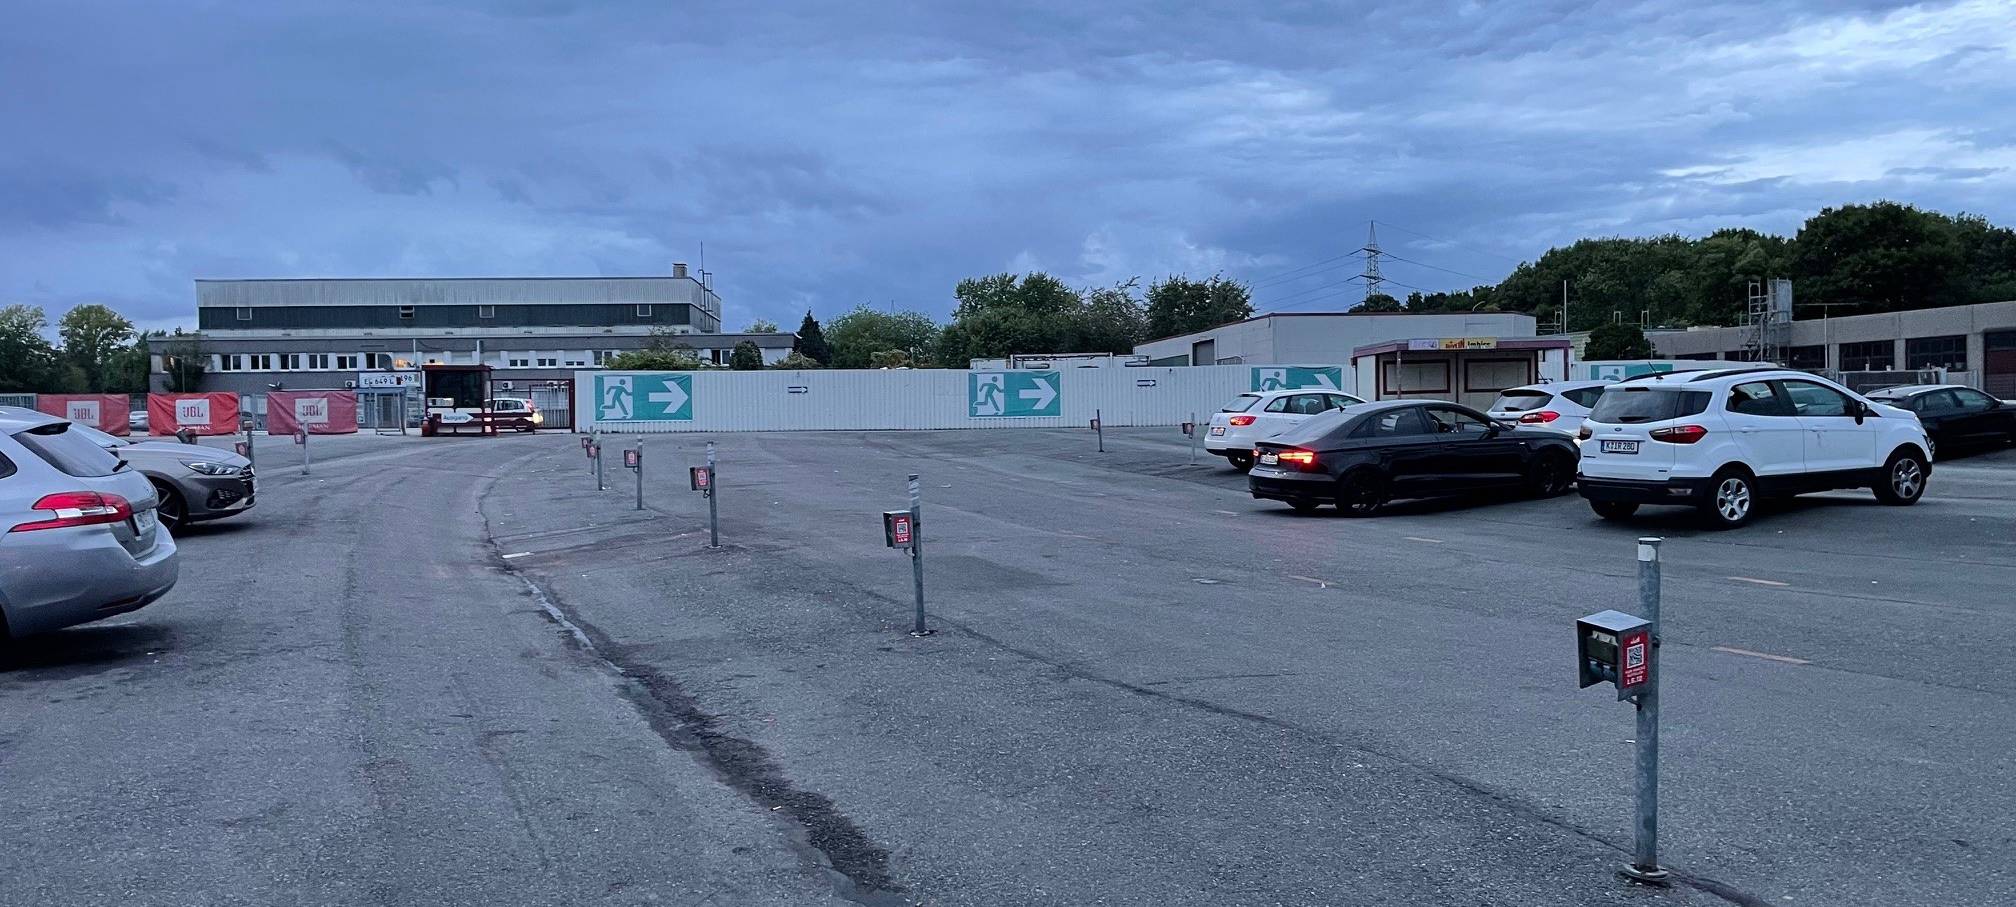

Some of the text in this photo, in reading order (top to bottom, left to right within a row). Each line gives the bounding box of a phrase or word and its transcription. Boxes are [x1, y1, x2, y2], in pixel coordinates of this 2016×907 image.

[73, 407, 94, 420] JBL
[182, 406, 204, 419] JBL
[302, 404, 323, 417] JBL
